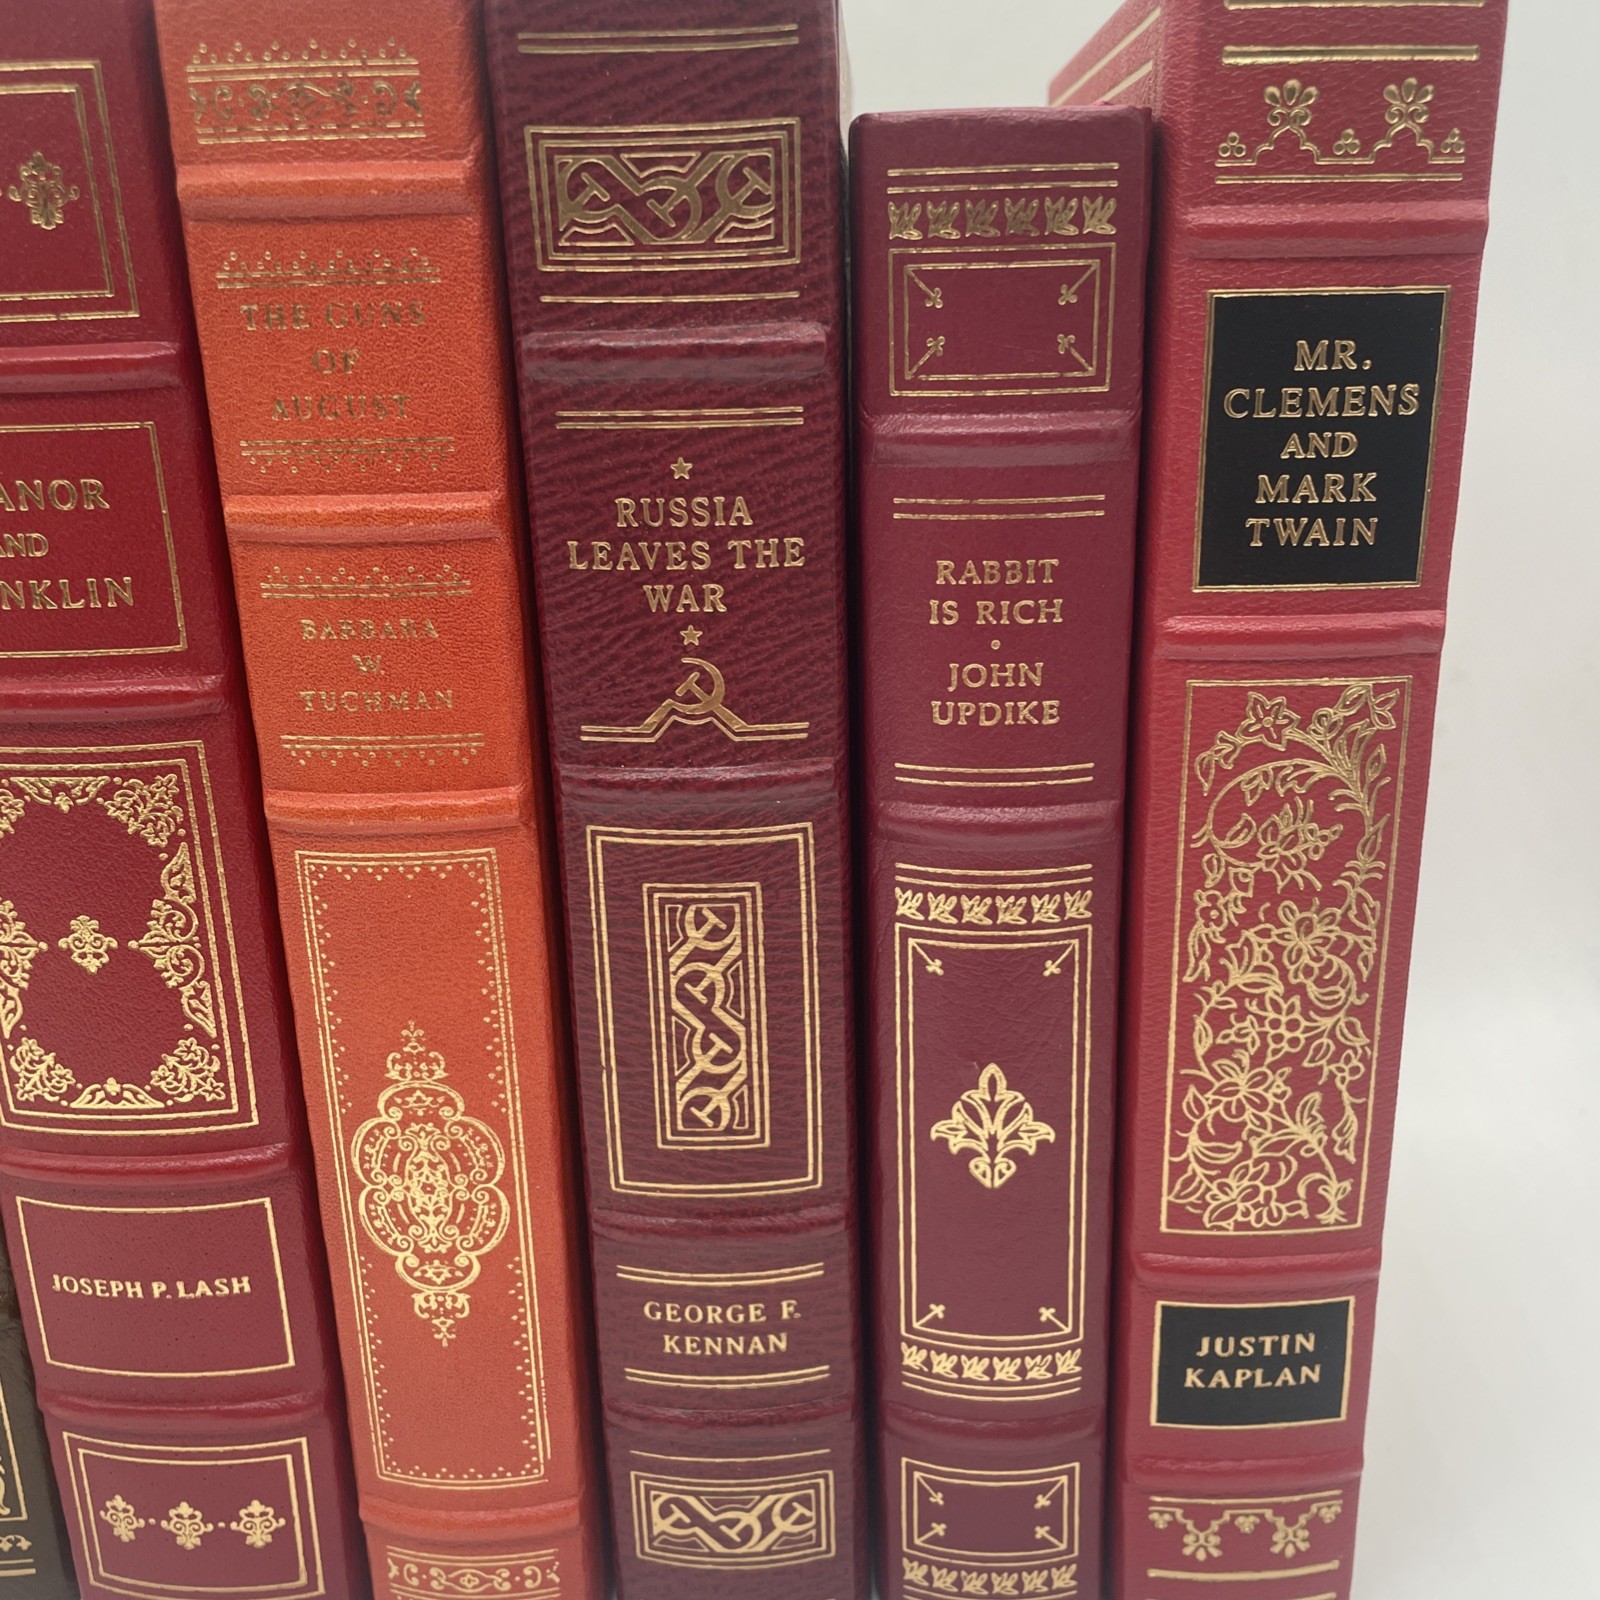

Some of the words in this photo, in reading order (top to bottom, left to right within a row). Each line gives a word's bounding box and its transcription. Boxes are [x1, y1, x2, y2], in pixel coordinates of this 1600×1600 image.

[240, 304, 310, 331] THE
[325, 301, 426, 329] GUNS
[312, 349, 362, 375] OF
[1293, 339, 1373, 371] MR.
[271, 394, 415, 421] AUGUST
[1223, 383, 1421, 419] CLEMENS
[1280, 432, 1359, 459] AND
[1254, 472, 1378, 504] MARK
[615, 496, 754, 528] RUSSIA
[1245, 517, 1379, 547] TWAIN
[566, 540, 712, 571] LEAVES
[727, 537, 806, 569] THE
[936, 558, 1060, 585] RABBIT
[643, 584, 728, 613] WAR
[929, 599, 960, 625] IS
[976, 598, 1064, 625] RICH
[300, 618, 440, 641] BARBARA
[947, 662, 1044, 692] JOHN
[299, 689, 454, 713] TUCHMAN
[931, 700, 1061, 727] UPDIKE
[52, 1273, 145, 1300] JOSEPH
[176, 1275, 252, 1300] LASH
[643, 1301, 767, 1325] GEORGE
[780, 1299, 802, 1321] F.
[662, 1332, 789, 1357] KENNAN
[1195, 1331, 1317, 1358] JUSTIN
[1183, 1363, 1322, 1390] KAPLAN
